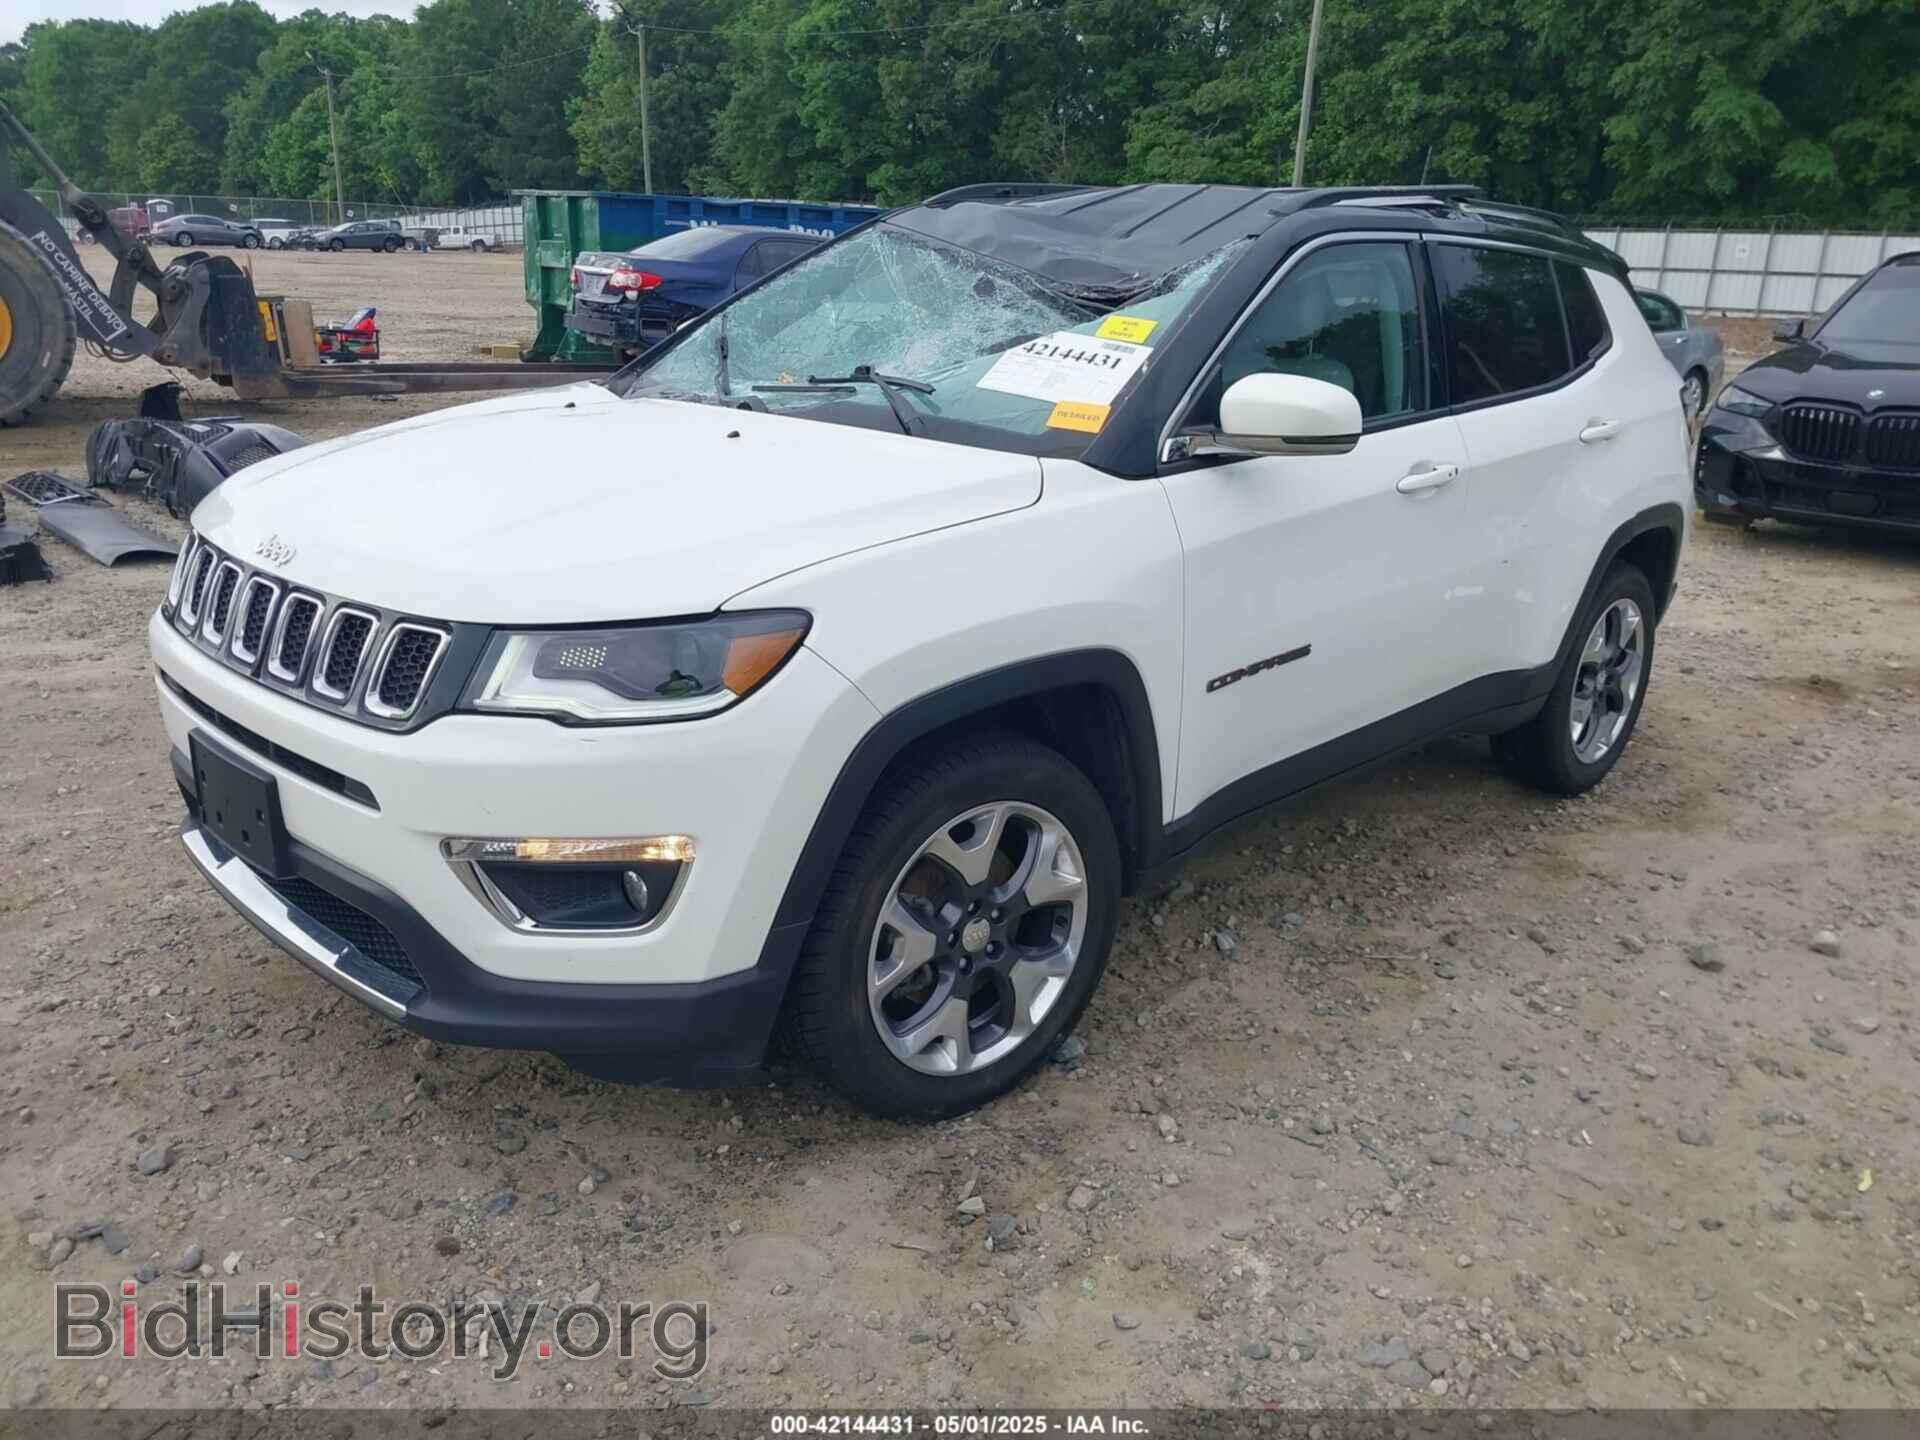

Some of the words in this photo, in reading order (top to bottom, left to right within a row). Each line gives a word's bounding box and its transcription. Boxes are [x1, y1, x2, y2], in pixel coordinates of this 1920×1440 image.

[39, 231, 56, 252] NO
[54, 252, 91, 294] CAMINE
[86, 292, 123, 331] DEBAJO
[1023, 343, 1122, 370] 42144431
[255, 534, 297, 568] Jeep
